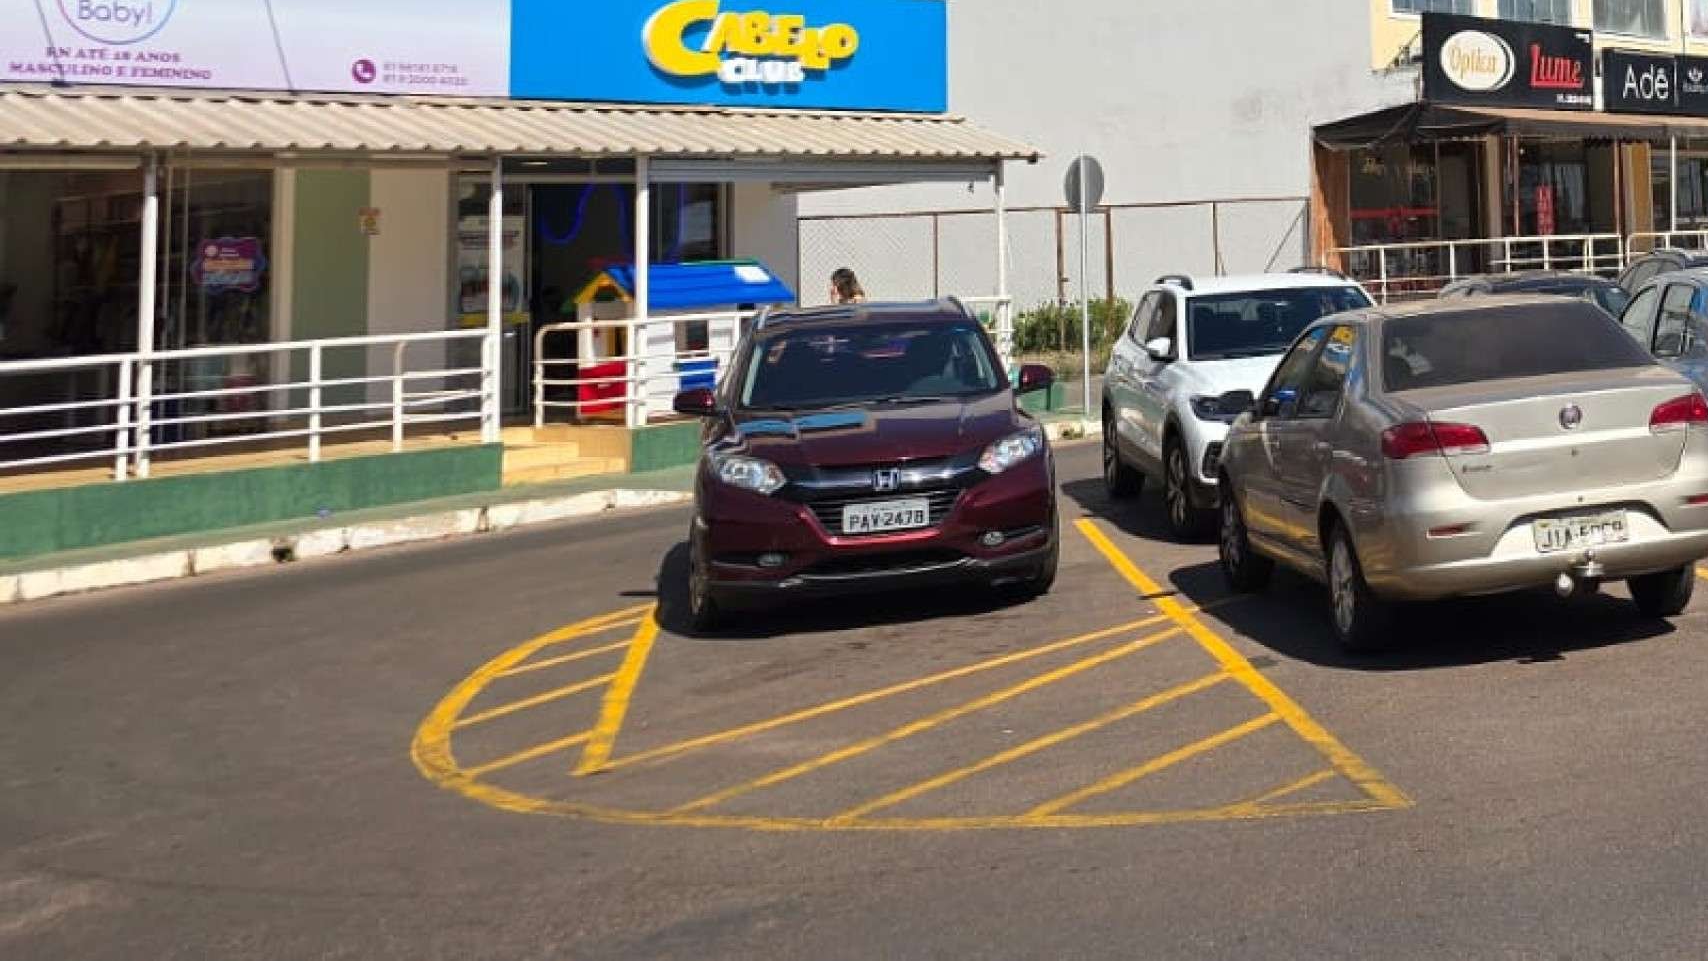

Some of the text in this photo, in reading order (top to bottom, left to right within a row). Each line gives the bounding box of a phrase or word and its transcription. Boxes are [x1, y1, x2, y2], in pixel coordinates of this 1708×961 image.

[135, 51, 181, 63] ANOS
[9, 61, 113, 77] MASCULINO
[131, 66, 212, 80] FEMININO
